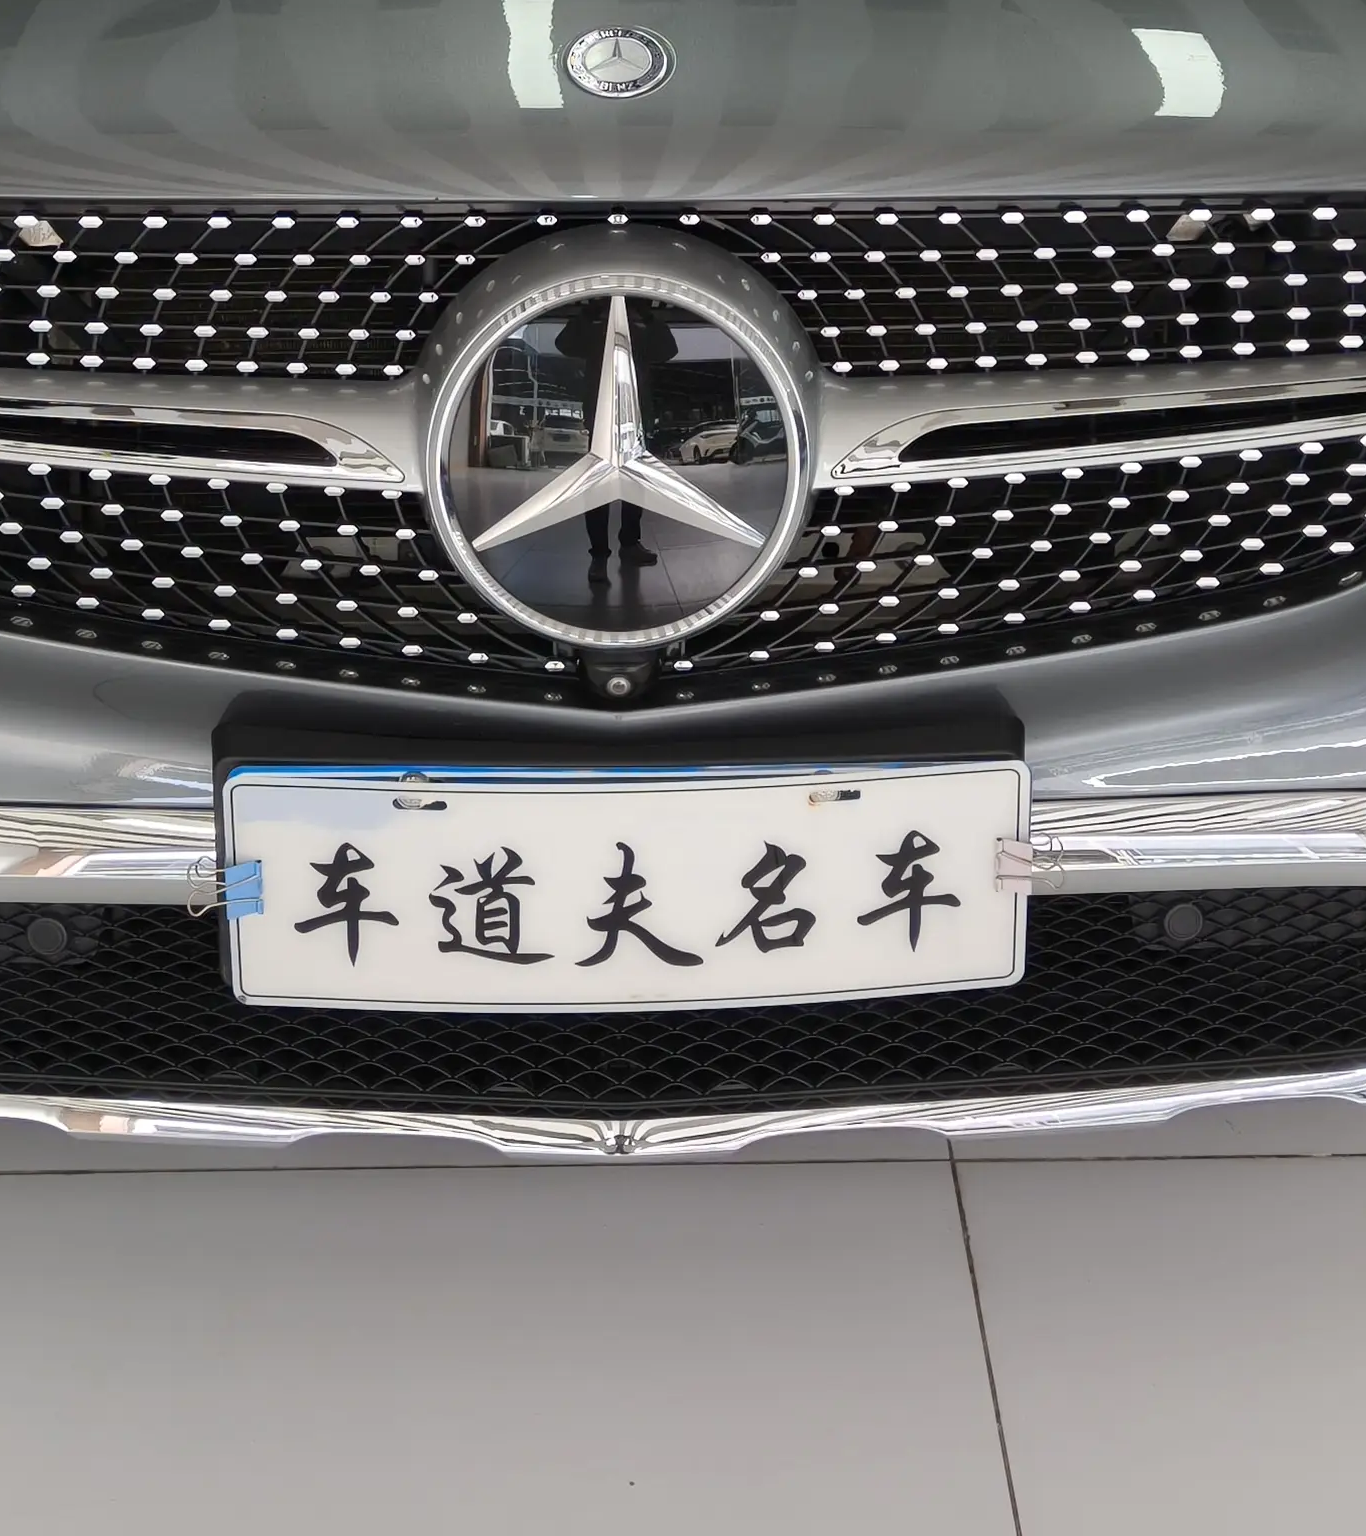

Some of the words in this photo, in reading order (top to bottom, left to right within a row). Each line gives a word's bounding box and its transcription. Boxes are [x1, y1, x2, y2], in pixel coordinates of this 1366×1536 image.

[295, 831, 960, 966] 车道夫名车
